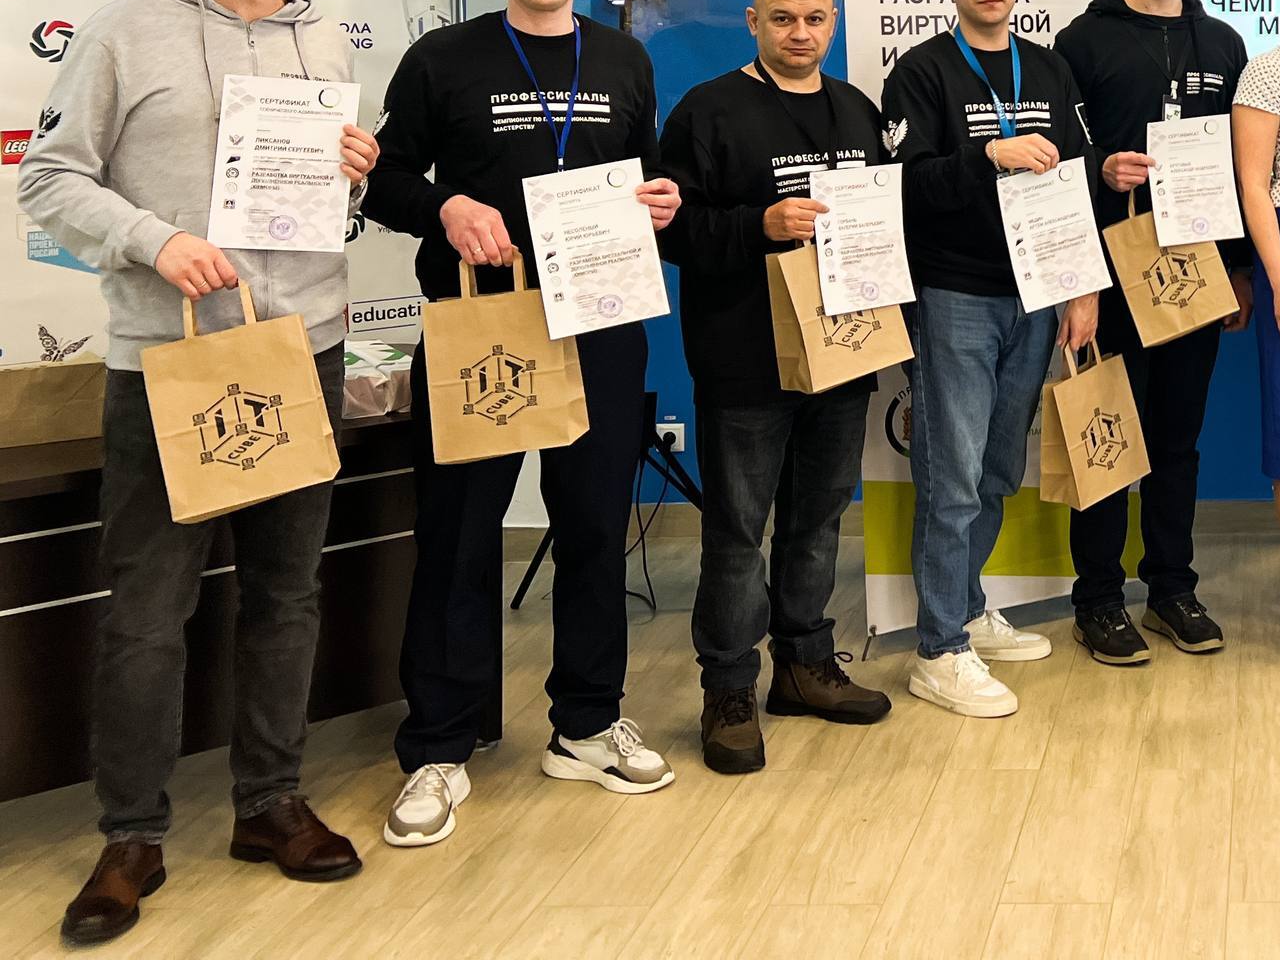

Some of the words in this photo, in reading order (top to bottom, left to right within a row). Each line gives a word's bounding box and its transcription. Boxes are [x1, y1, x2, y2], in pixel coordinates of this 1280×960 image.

[259, 96, 312, 108] СЕРТИФИКАТ
[492, 116, 532, 125] ЧЕМПИОНАТ
[493, 124, 535, 133] МАСТЕРСТВУ
[4, 140, 29, 154] LEG
[771, 149, 865, 167] ПРОФЕССИНАЛЫ
[556, 184, 601, 199] СЕРТИФИКАТ
[1169, 281, 1188, 302] CUBE
[351, 301, 422, 324] educati
[841, 322, 863, 343] CUBE
[485, 393, 515, 415] CUBE
[228, 434, 261, 460] CUBE
[1099, 443, 1114, 464] CUBE
